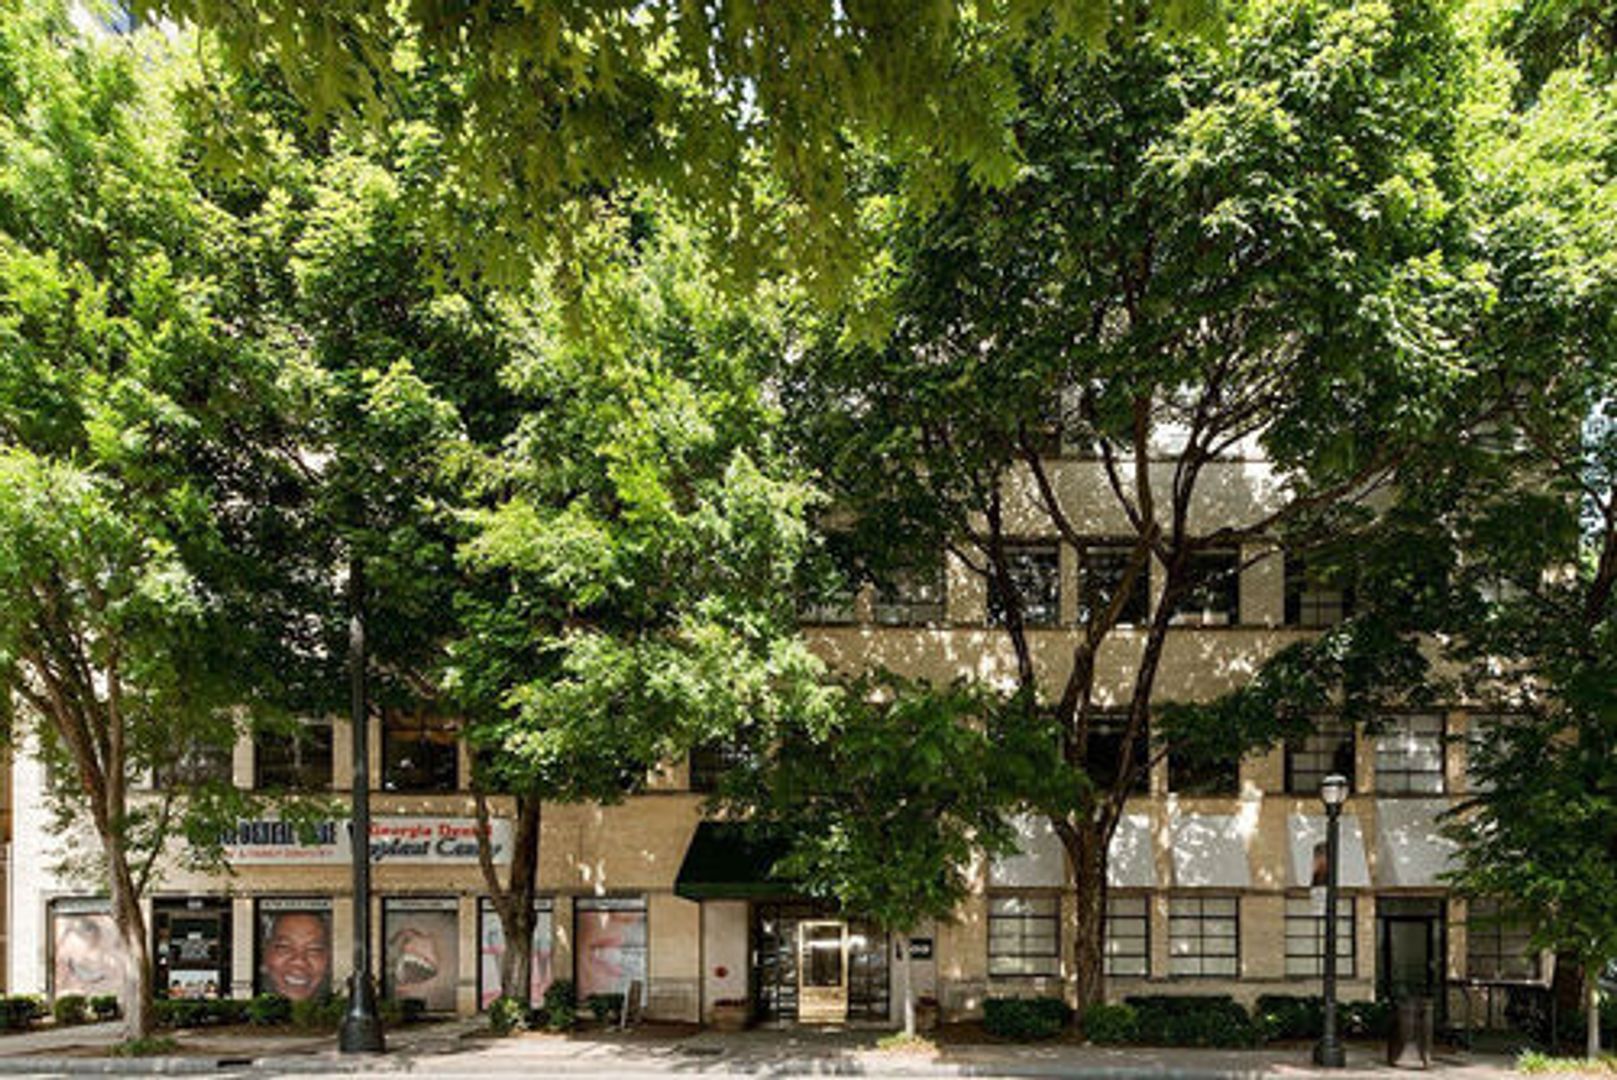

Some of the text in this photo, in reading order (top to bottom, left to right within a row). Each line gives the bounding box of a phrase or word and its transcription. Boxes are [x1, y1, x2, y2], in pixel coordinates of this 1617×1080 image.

[368, 822, 493, 838] Georgia Dentl
[367, 837, 431, 861] mplant
